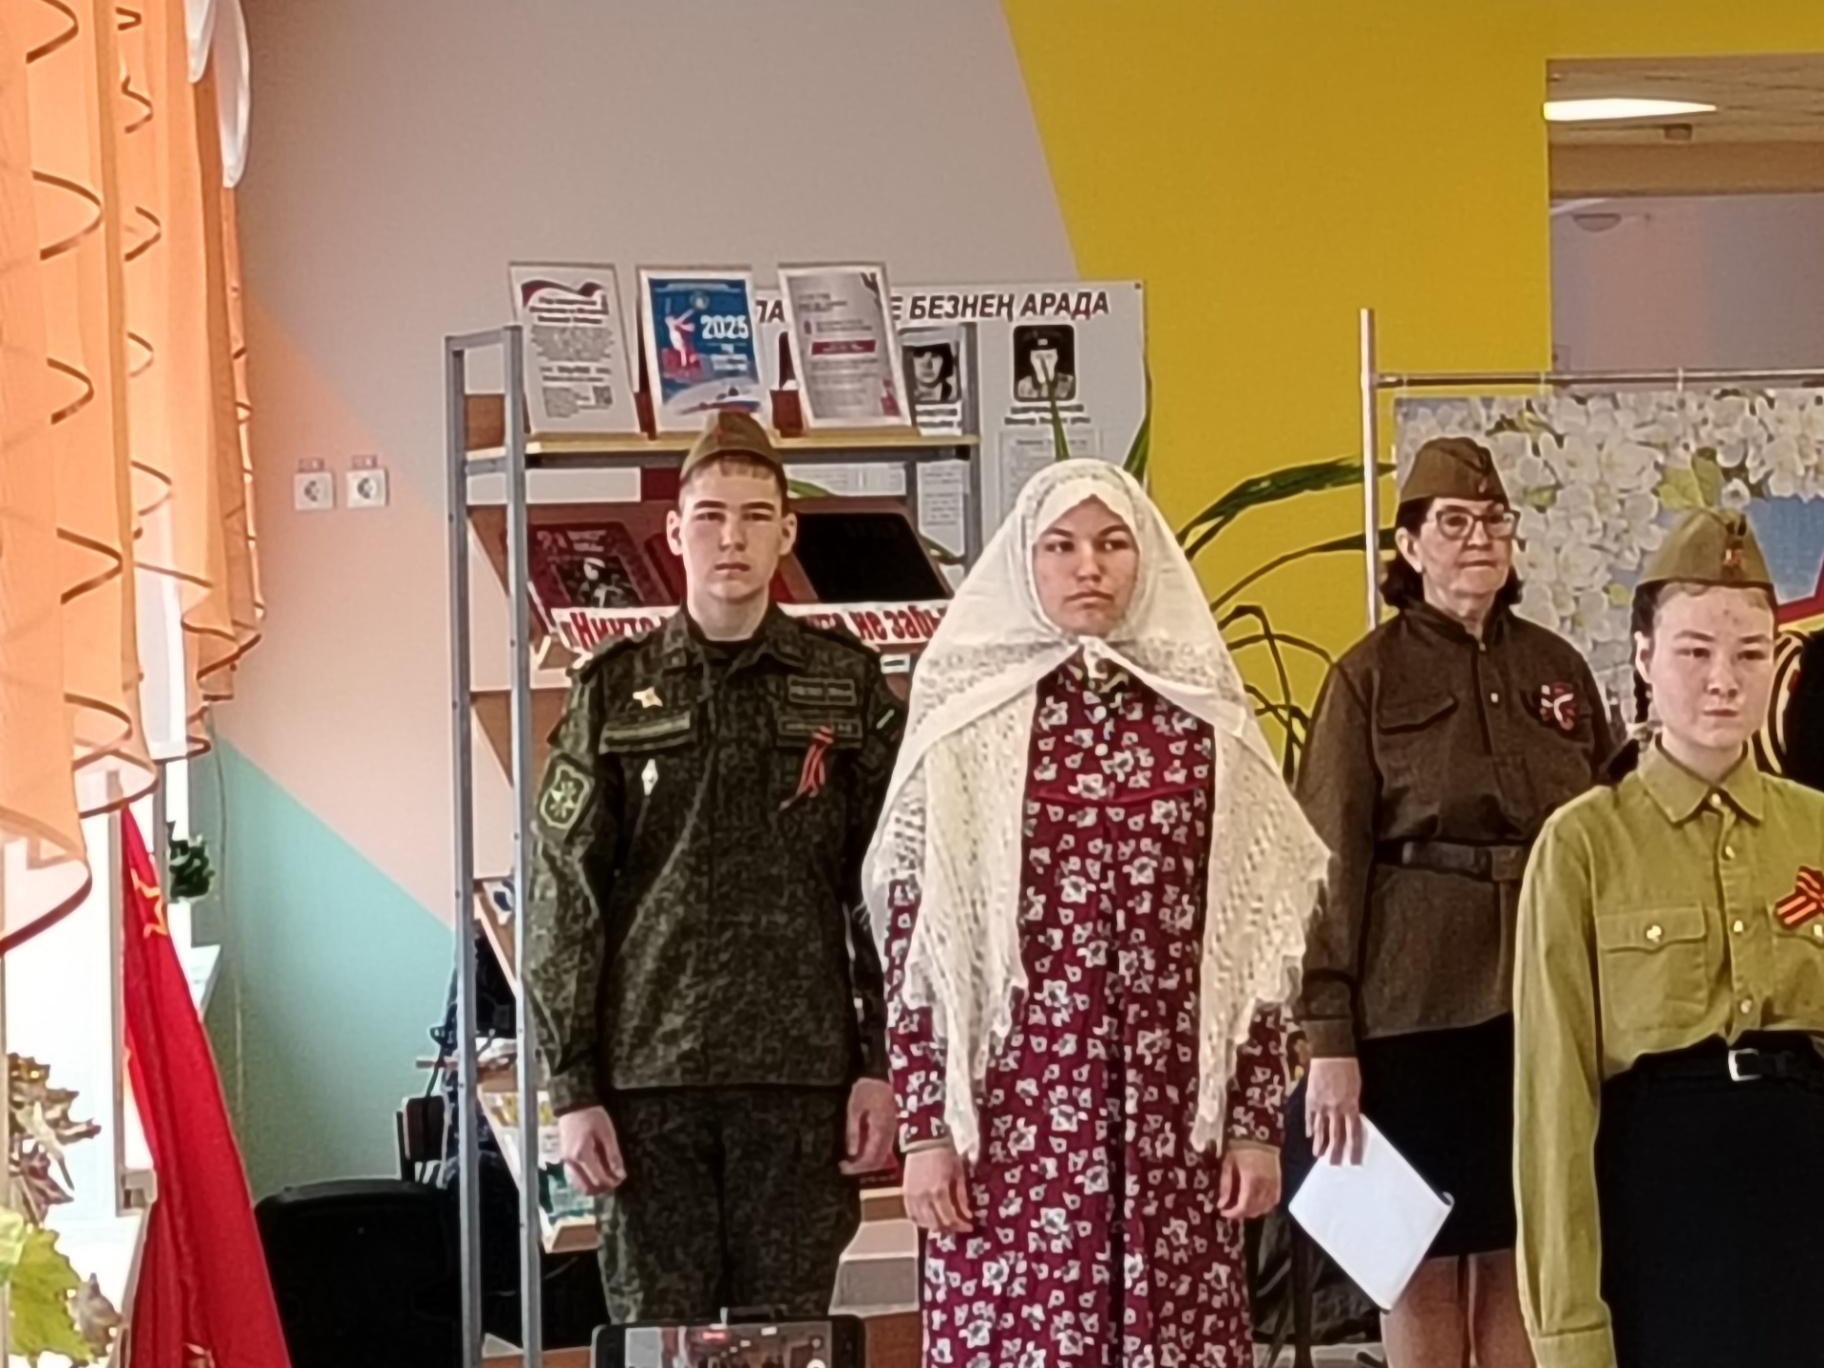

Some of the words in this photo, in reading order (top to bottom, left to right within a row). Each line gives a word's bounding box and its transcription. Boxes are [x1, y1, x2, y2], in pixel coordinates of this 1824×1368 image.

[909, 294, 1015, 322] БЕЗНЕҢ
[1020, 291, 1109, 320] АРАДА
[701, 314, 749, 339] 2025
